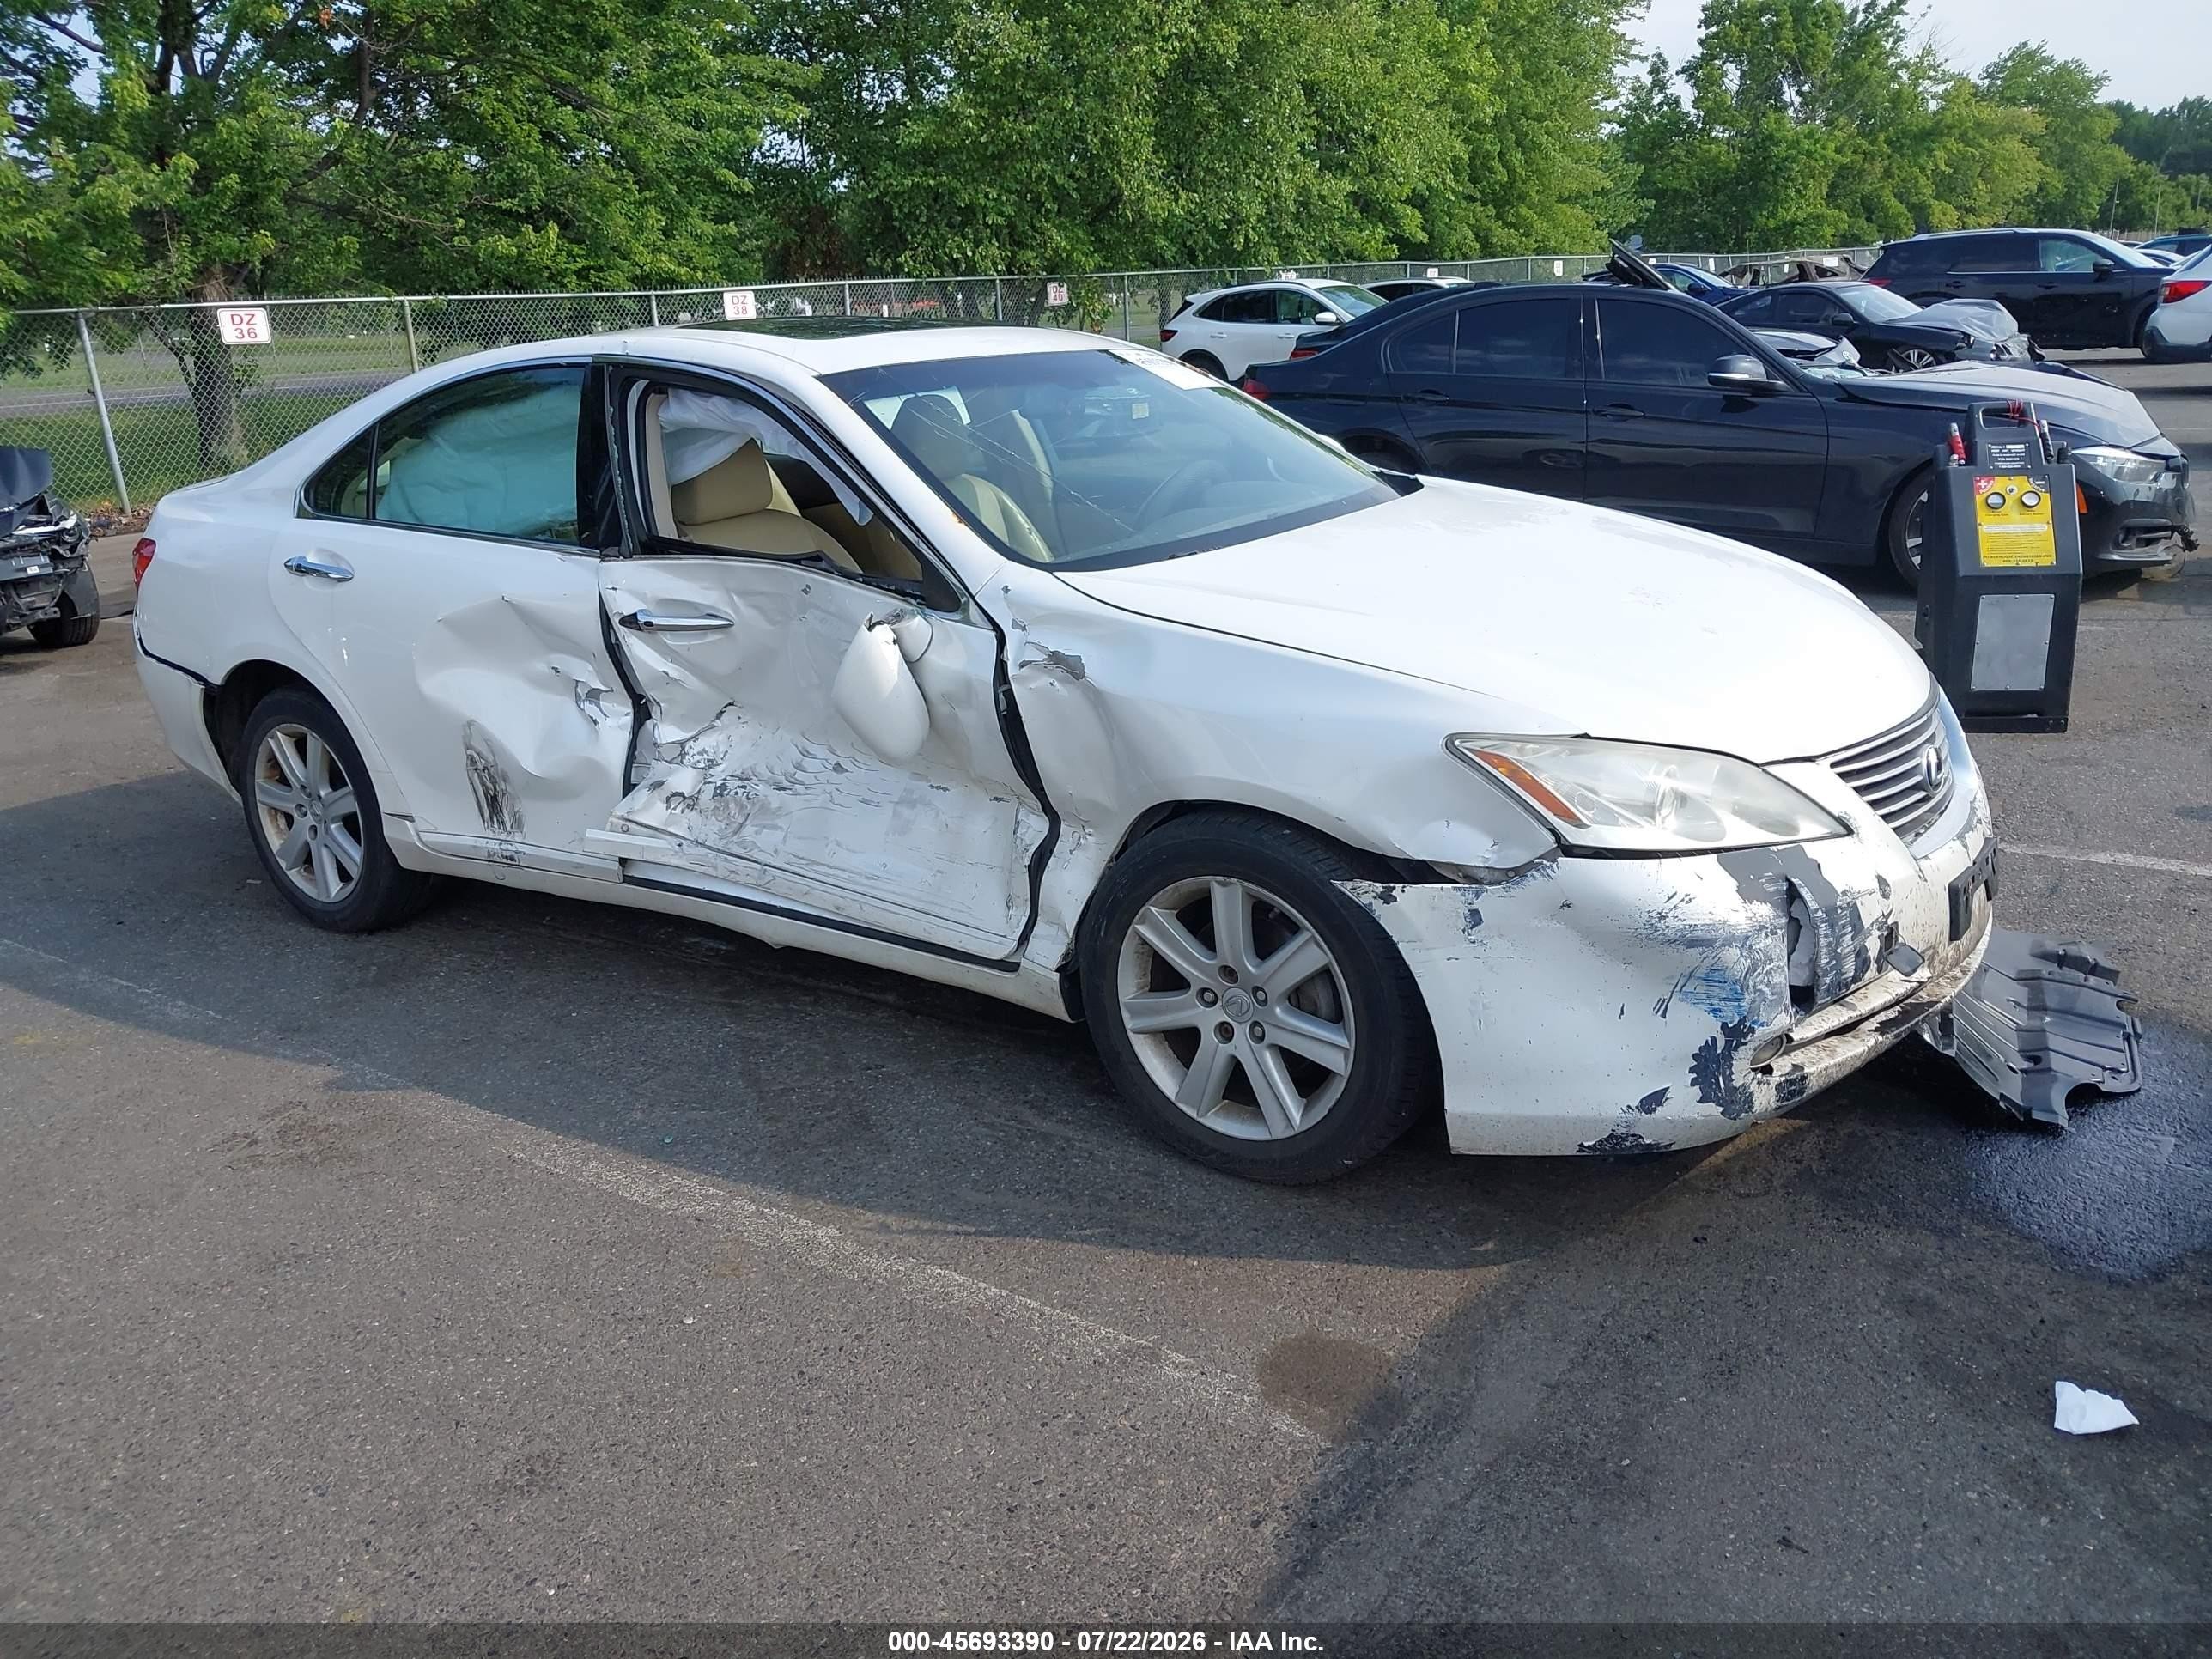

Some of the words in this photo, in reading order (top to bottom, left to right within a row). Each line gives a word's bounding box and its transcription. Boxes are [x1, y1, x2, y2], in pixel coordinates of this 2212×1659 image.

[732, 295, 748, 305] DZ
[733, 306, 747, 315] 38
[230, 313, 256, 325] DZ
[234, 327, 257, 339] 36
